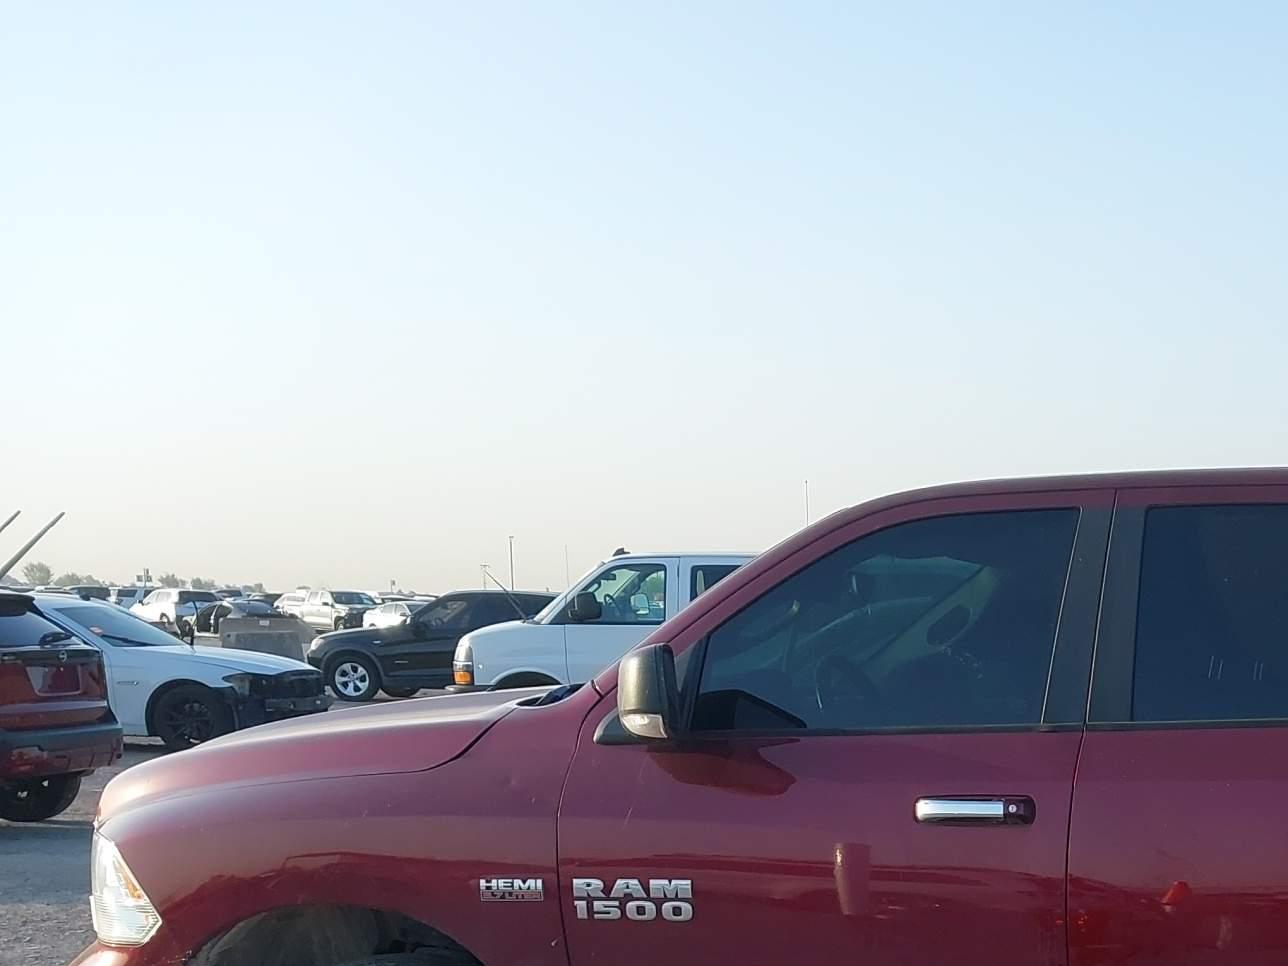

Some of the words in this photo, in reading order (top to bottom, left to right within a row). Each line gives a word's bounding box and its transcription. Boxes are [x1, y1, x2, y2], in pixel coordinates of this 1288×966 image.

[479, 878, 544, 891] HEMI
[572, 878, 692, 898] RAM
[574, 900, 693, 921] 1500
